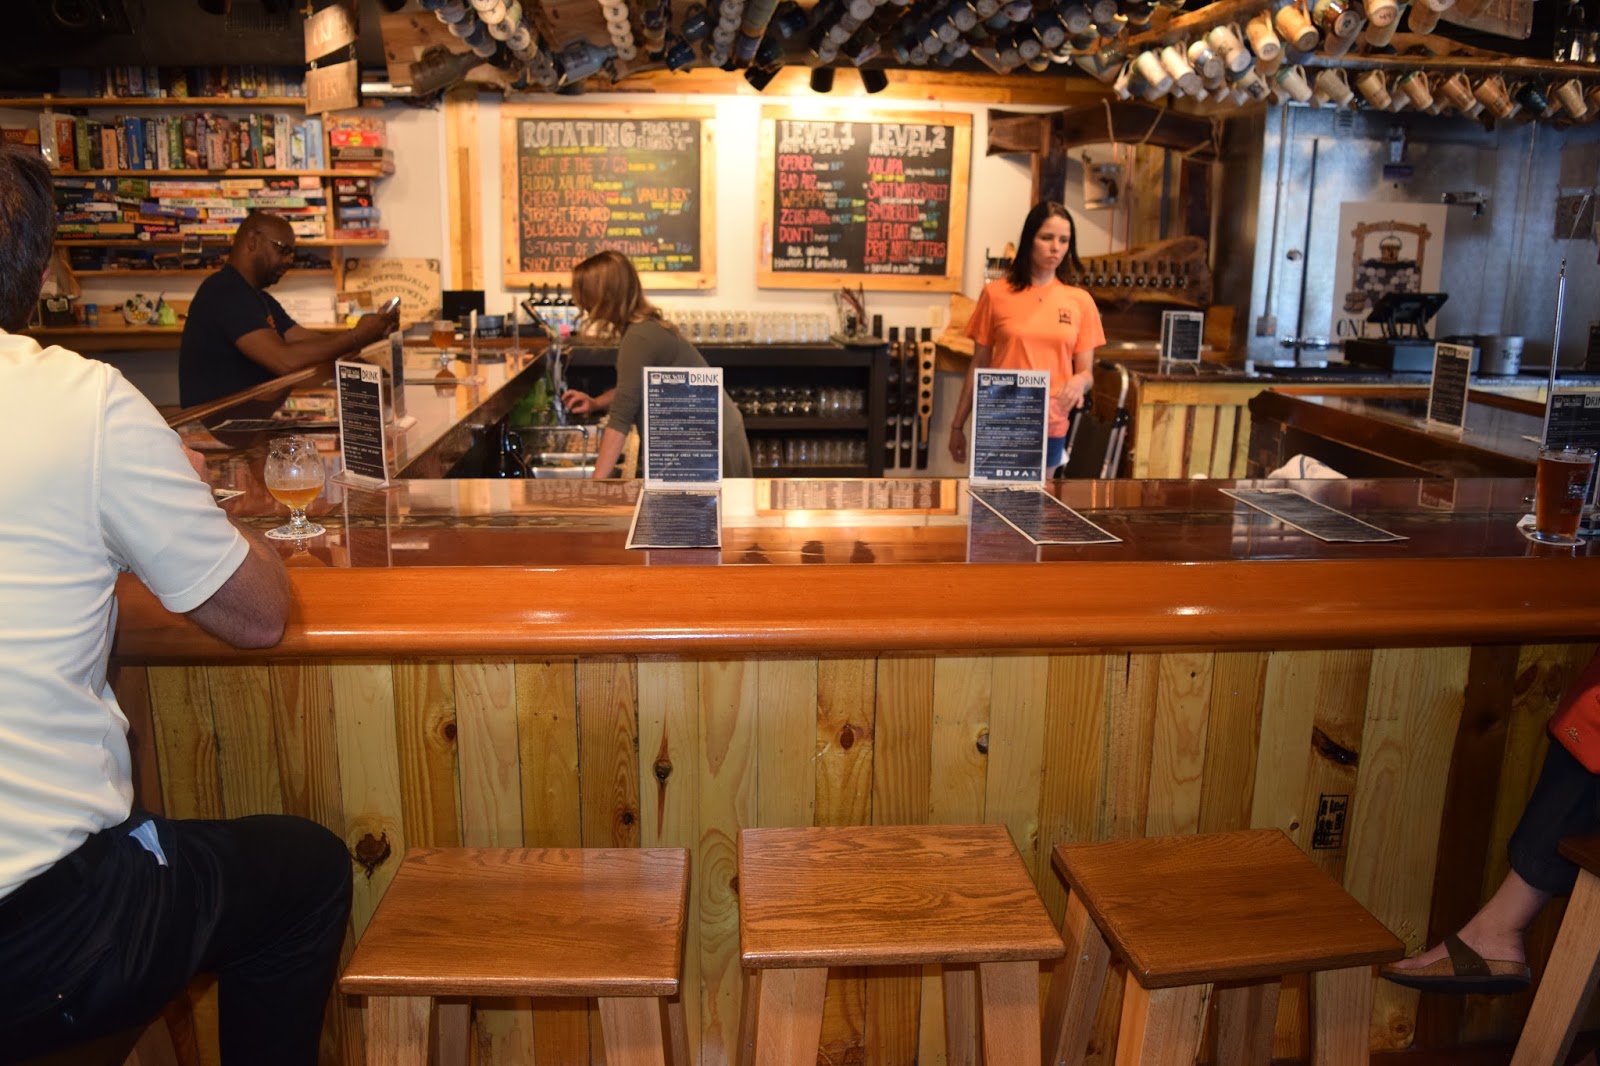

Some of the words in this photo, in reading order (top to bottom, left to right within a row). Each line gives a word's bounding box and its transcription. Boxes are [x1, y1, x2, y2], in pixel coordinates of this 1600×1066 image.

[522, 121, 636, 148] ROTATING
[781, 121, 839, 145] LEVEL
[841, 122, 855, 145] 1
[871, 124, 931, 147] LEVEL
[931, 126, 946, 149] 2
[521, 157, 554, 174] FLIGHT
[559, 157, 571, 174] OF
[573, 157, 593, 173] THE
[779, 172, 799, 190] BAD
[585, 222, 608, 239] SKY
[575, 241, 588, 256] OF
[595, 240, 658, 255] SOMETHING
[362, 370, 378, 381] DRINK
[690, 373, 719, 383] DRINK
[1019, 376, 1046, 385] DRINK
[1585, 397, 1600, 406] DRI
